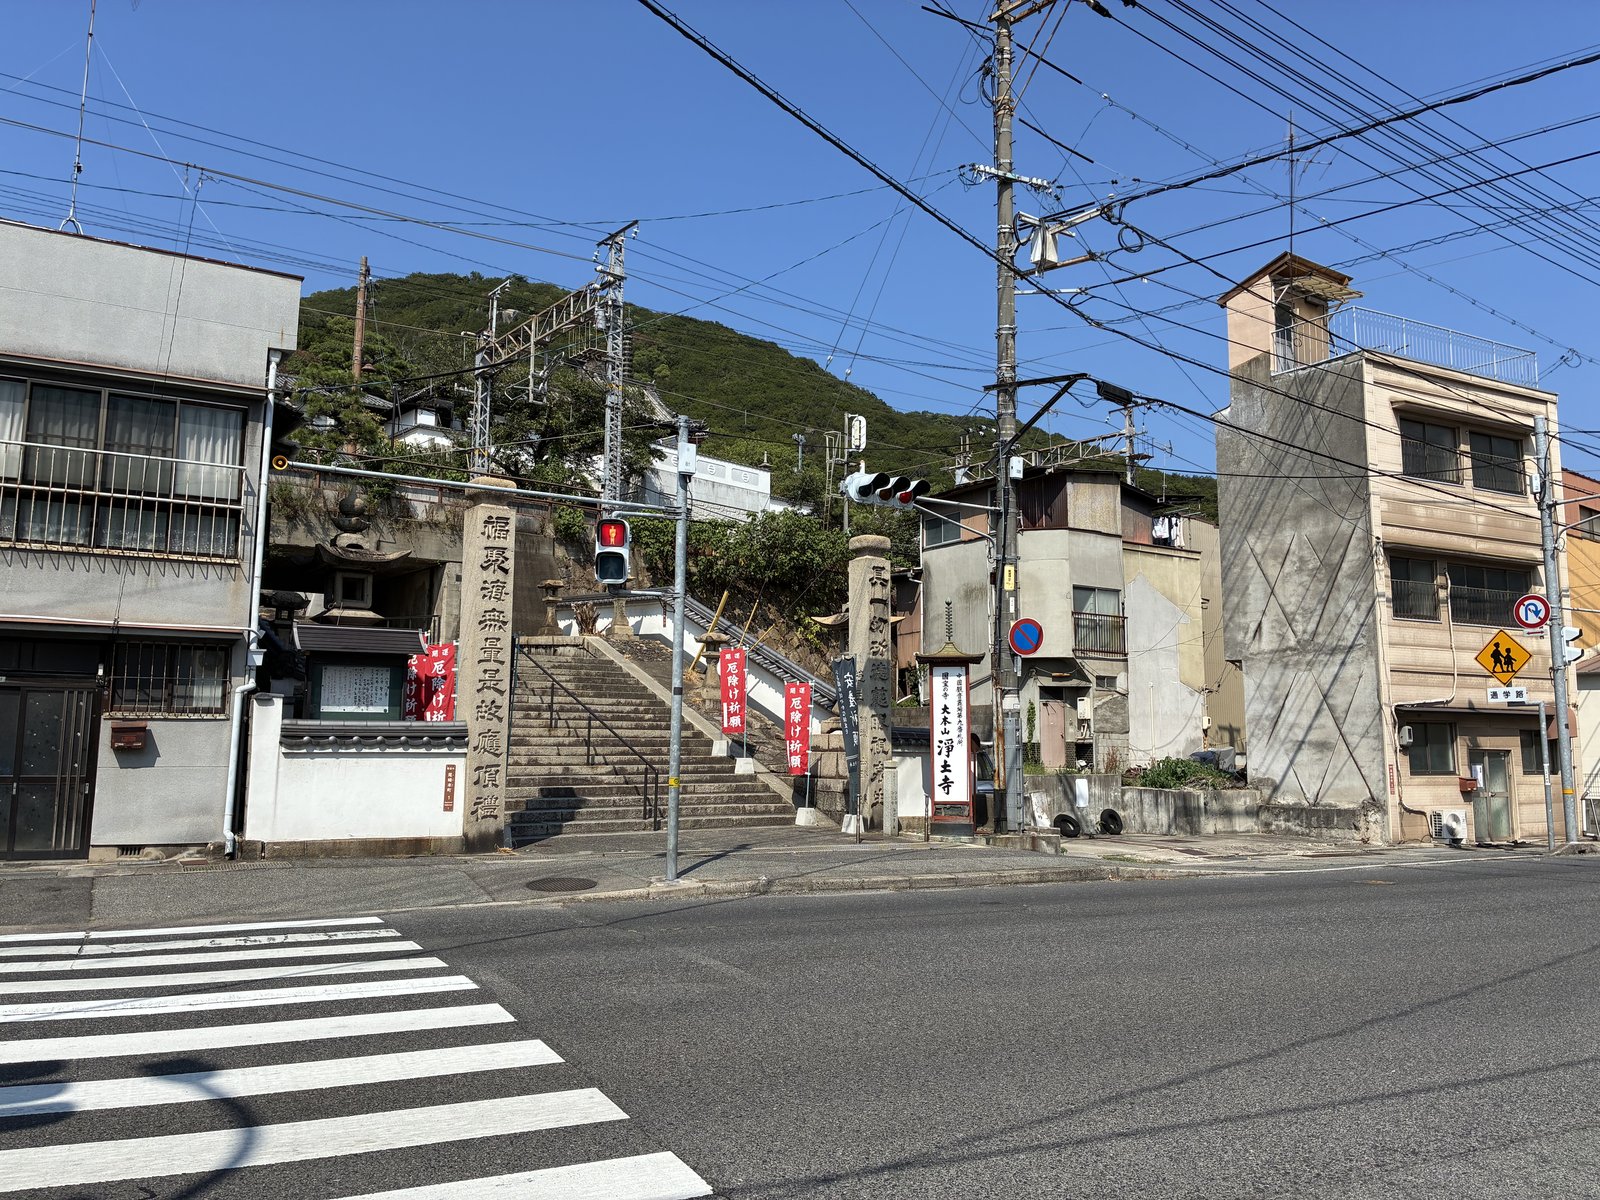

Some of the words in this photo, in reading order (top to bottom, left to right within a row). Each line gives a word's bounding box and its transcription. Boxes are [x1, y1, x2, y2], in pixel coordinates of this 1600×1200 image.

[726, 662, 742, 727] 厄除け祈願
[1490, 690, 1524, 700] 通学路
[789, 697, 803, 768] 厄除け祈願
[940, 704, 952, 735] 大本山
